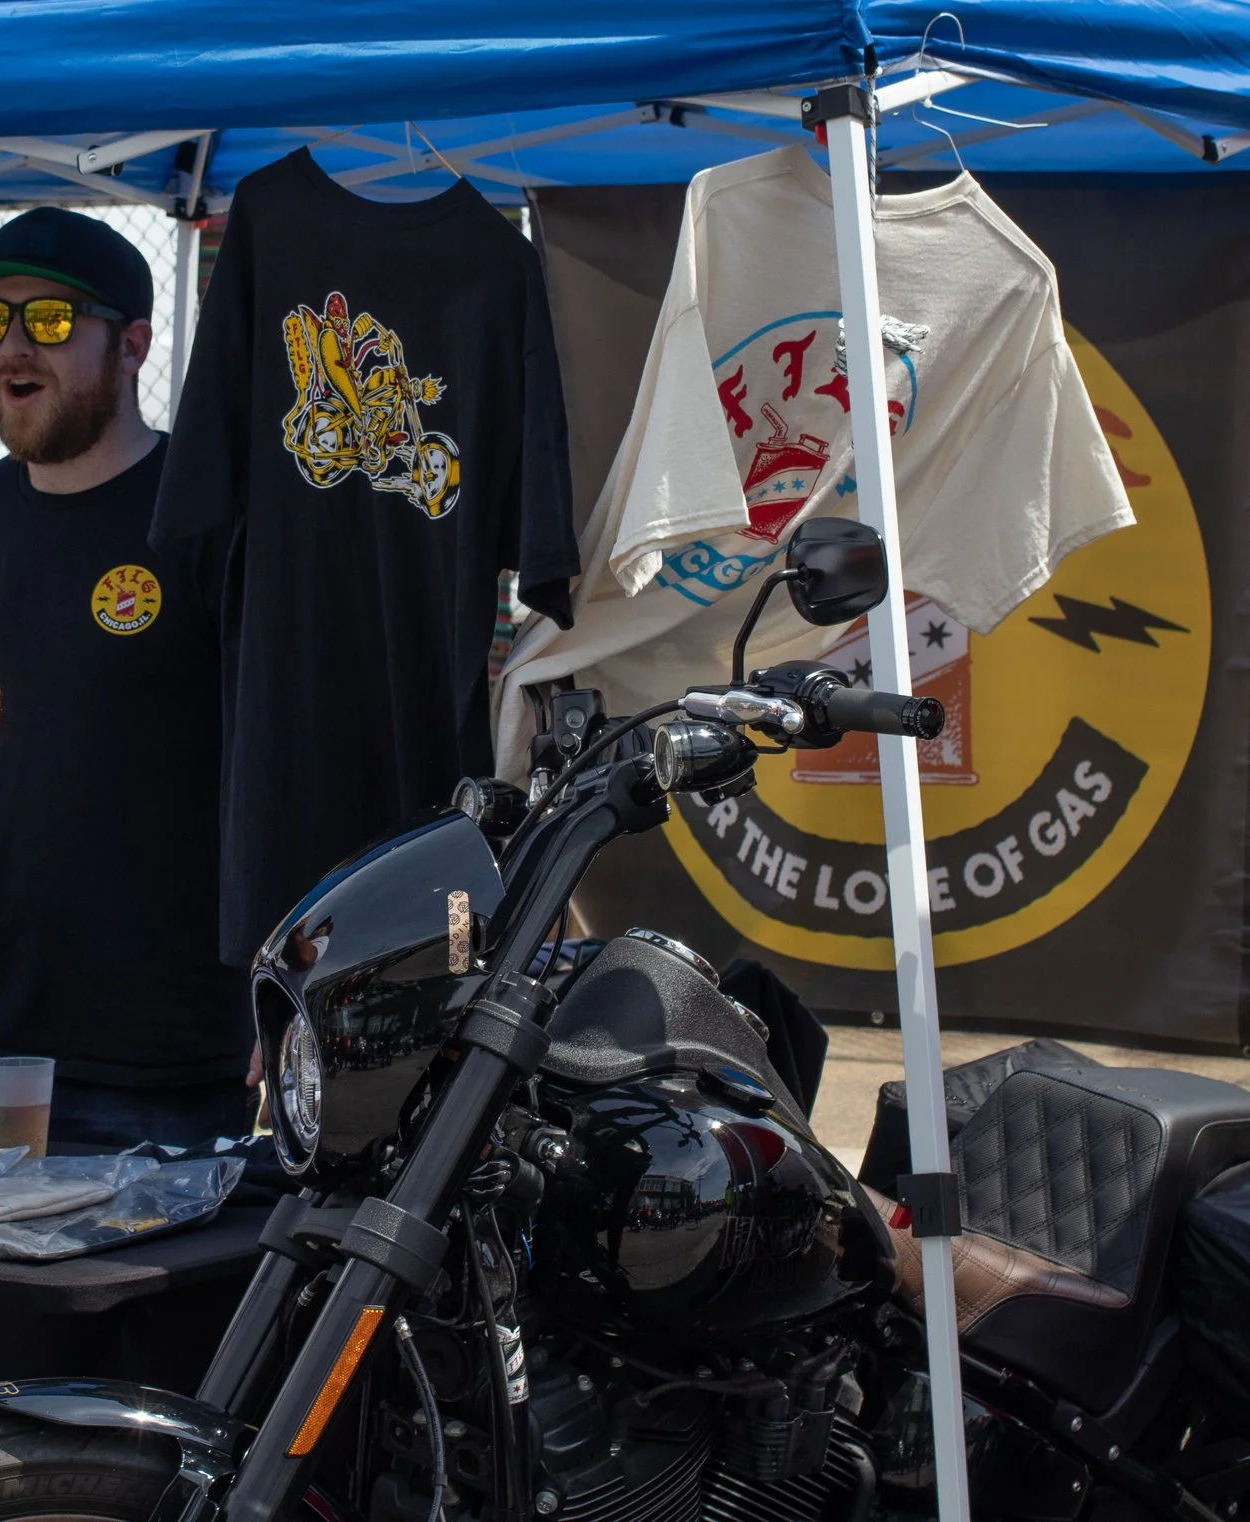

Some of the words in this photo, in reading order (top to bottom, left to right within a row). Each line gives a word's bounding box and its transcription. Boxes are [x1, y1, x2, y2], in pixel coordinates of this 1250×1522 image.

[737, 817, 807, 900] THE
[814, 864, 957, 915] LOE
[963, 835, 1024, 899] OF
[1029, 760, 1112, 856] GAS
